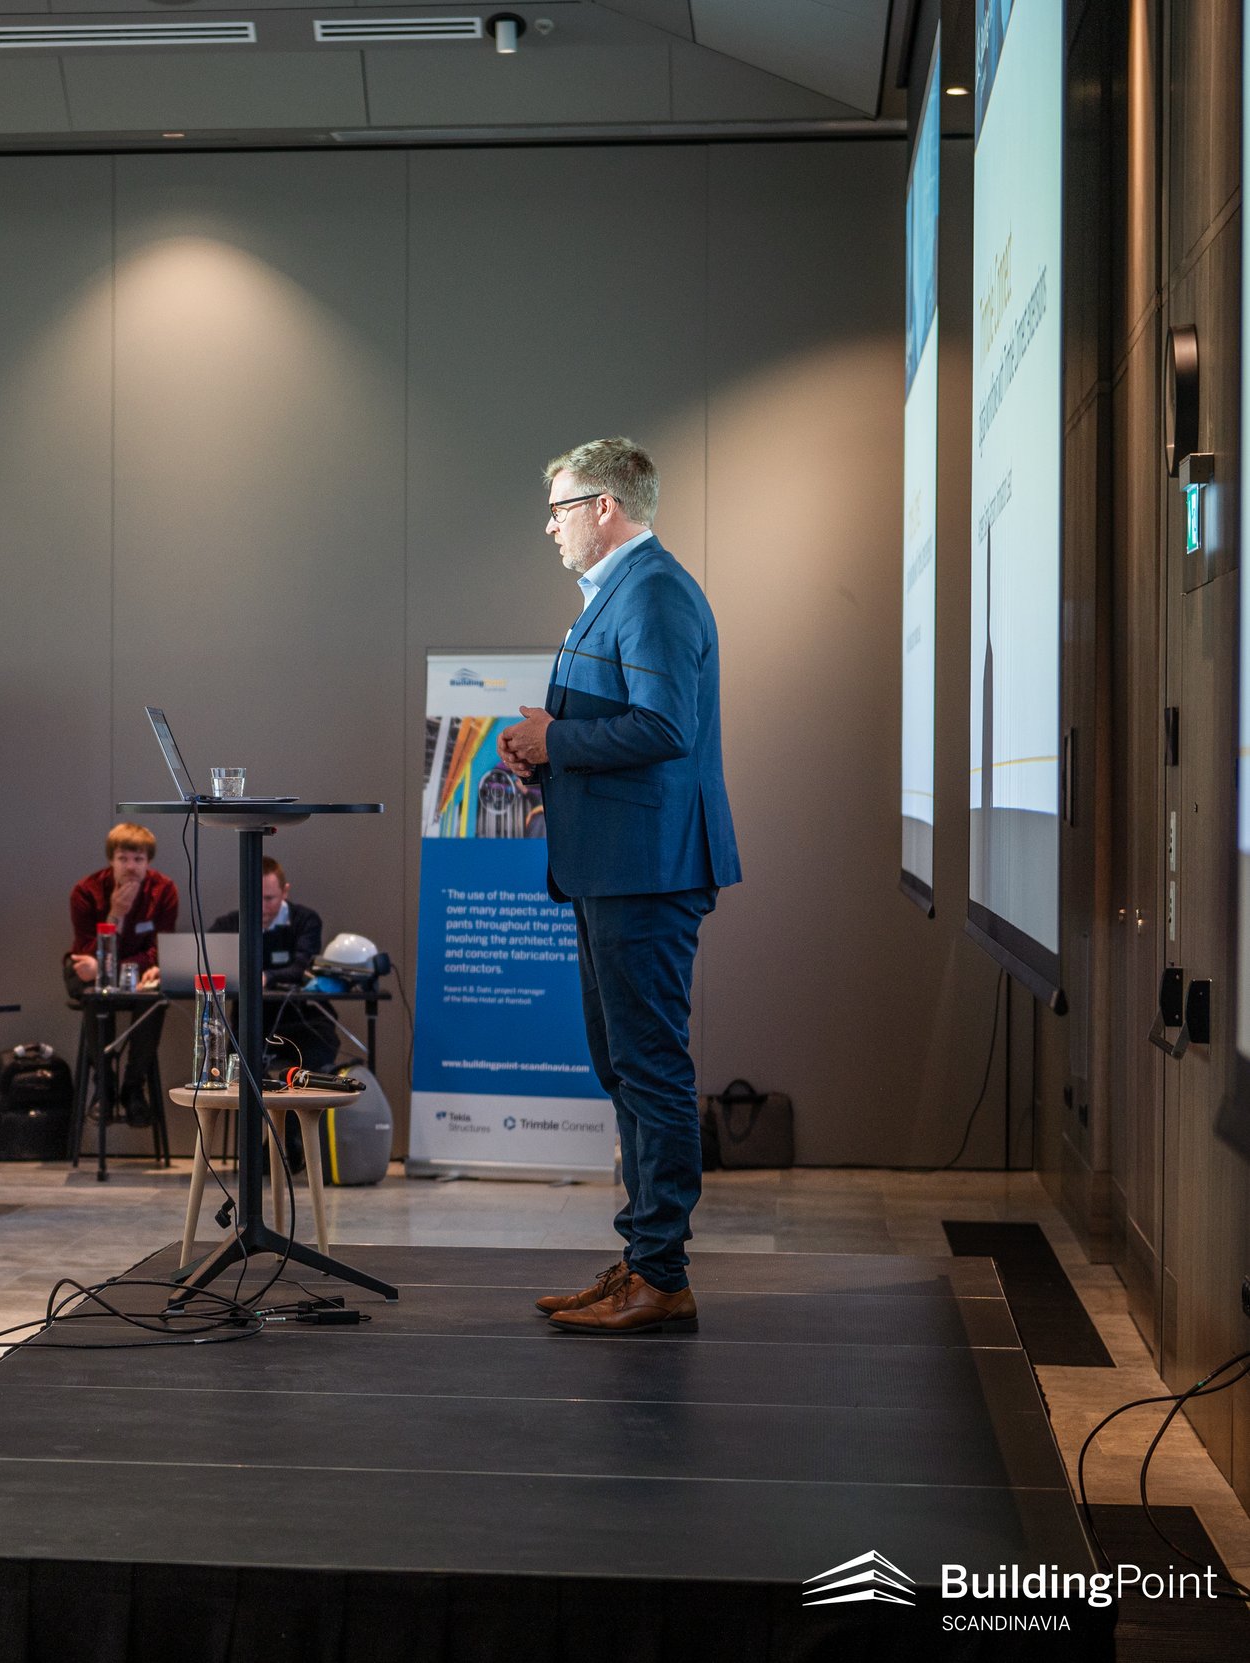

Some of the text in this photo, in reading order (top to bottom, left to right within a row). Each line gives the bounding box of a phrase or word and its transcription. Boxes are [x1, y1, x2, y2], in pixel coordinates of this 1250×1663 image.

[467, 891, 485, 900] use
[487, 890, 497, 900] of
[500, 891, 515, 901] the
[446, 906, 575, 918] over many aspects and pa
[446, 919, 473, 930] pants
[475, 919, 530, 932] throughout
[533, 921, 549, 930] the
[446, 934, 488, 946] involving
[491, 934, 506, 945] the
[445, 948, 463, 958] and
[465, 949, 509, 960] concrete
[511, 949, 565, 961] fabricators
[444, 962, 503, 974] contractors.
[442, 1059, 590, 1073] www.buildingpoint-scandinavia.com
[449, 1123, 491, 1133] Structures
[520, 1118, 604, 1133] Trimble Connect
